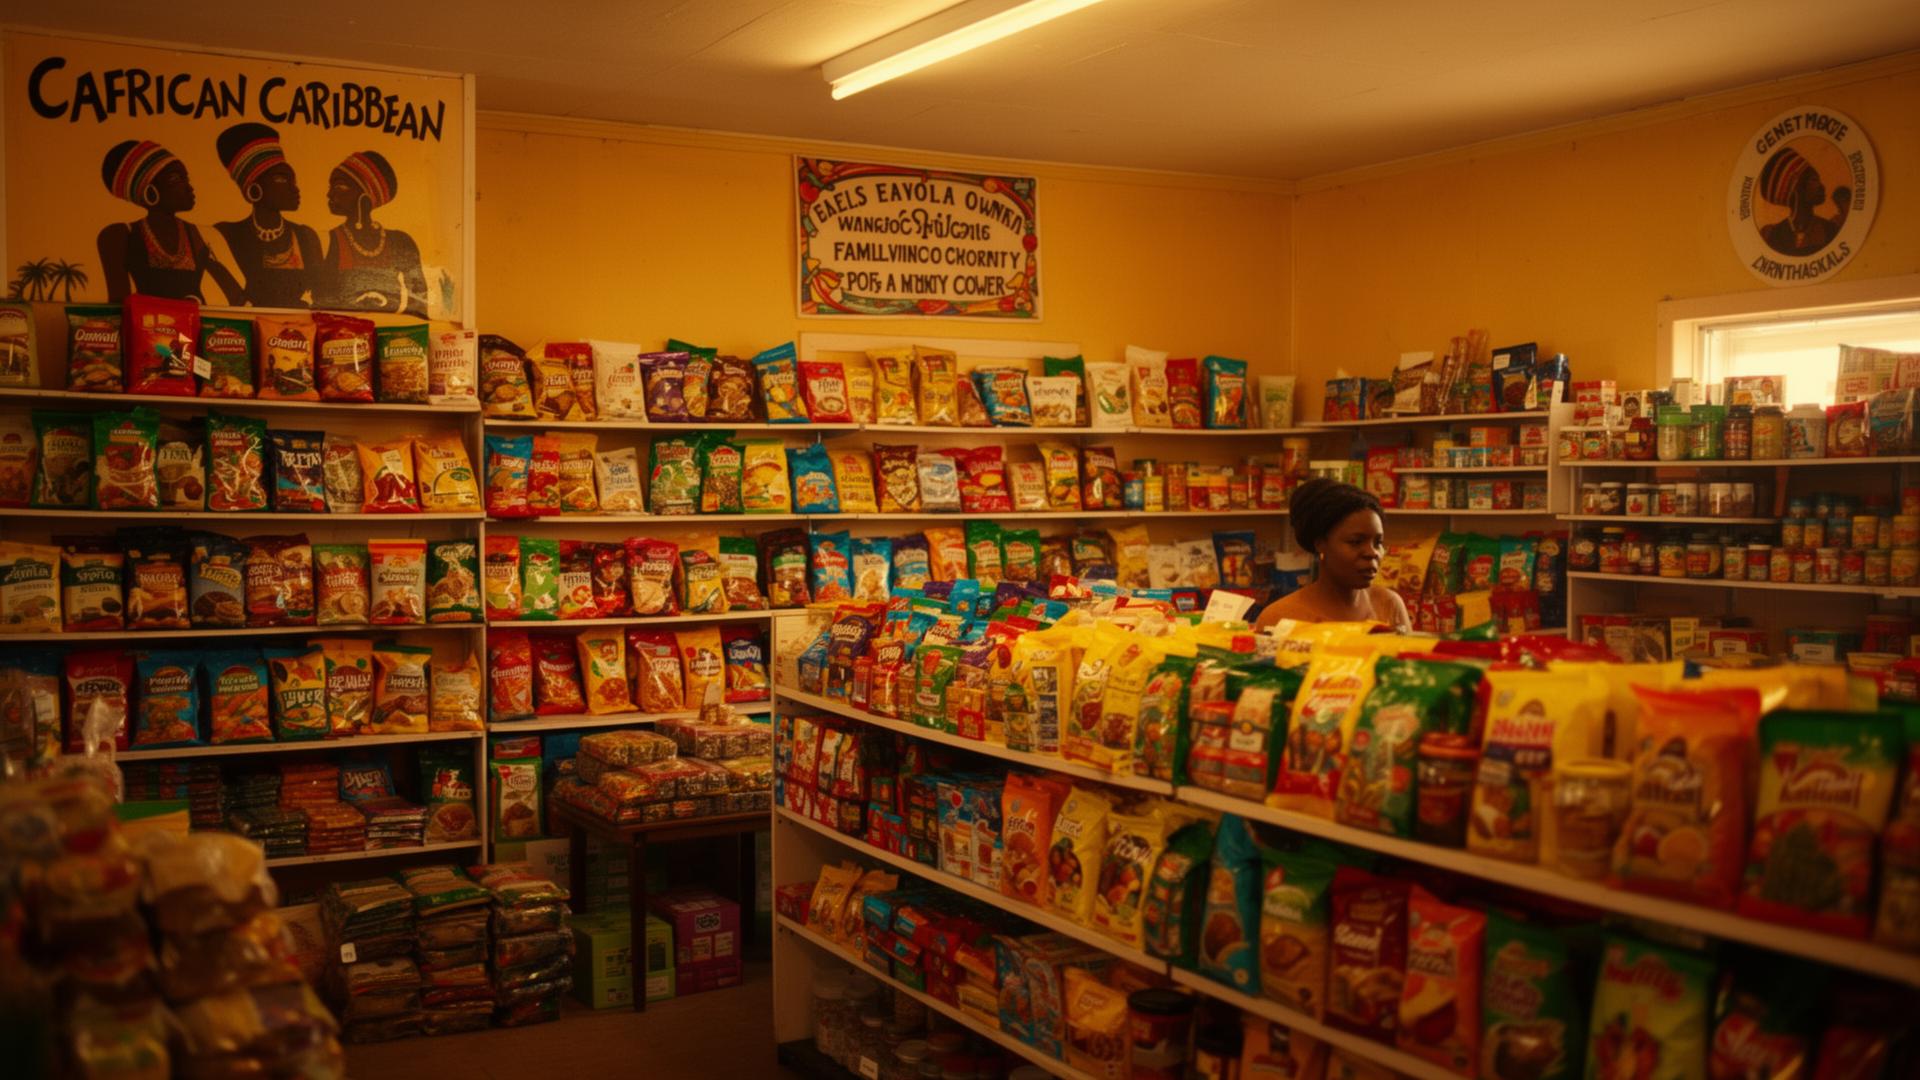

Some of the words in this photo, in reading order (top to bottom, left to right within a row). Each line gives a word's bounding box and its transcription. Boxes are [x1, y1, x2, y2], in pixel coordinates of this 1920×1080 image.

[28, 57, 247, 124] CAFRICAN
[259, 77, 446, 142] CARIBBEAN
[813, 185, 868, 223] EAELS
[886, 273, 896, 292] A
[953, 275, 1005, 295] COWER
